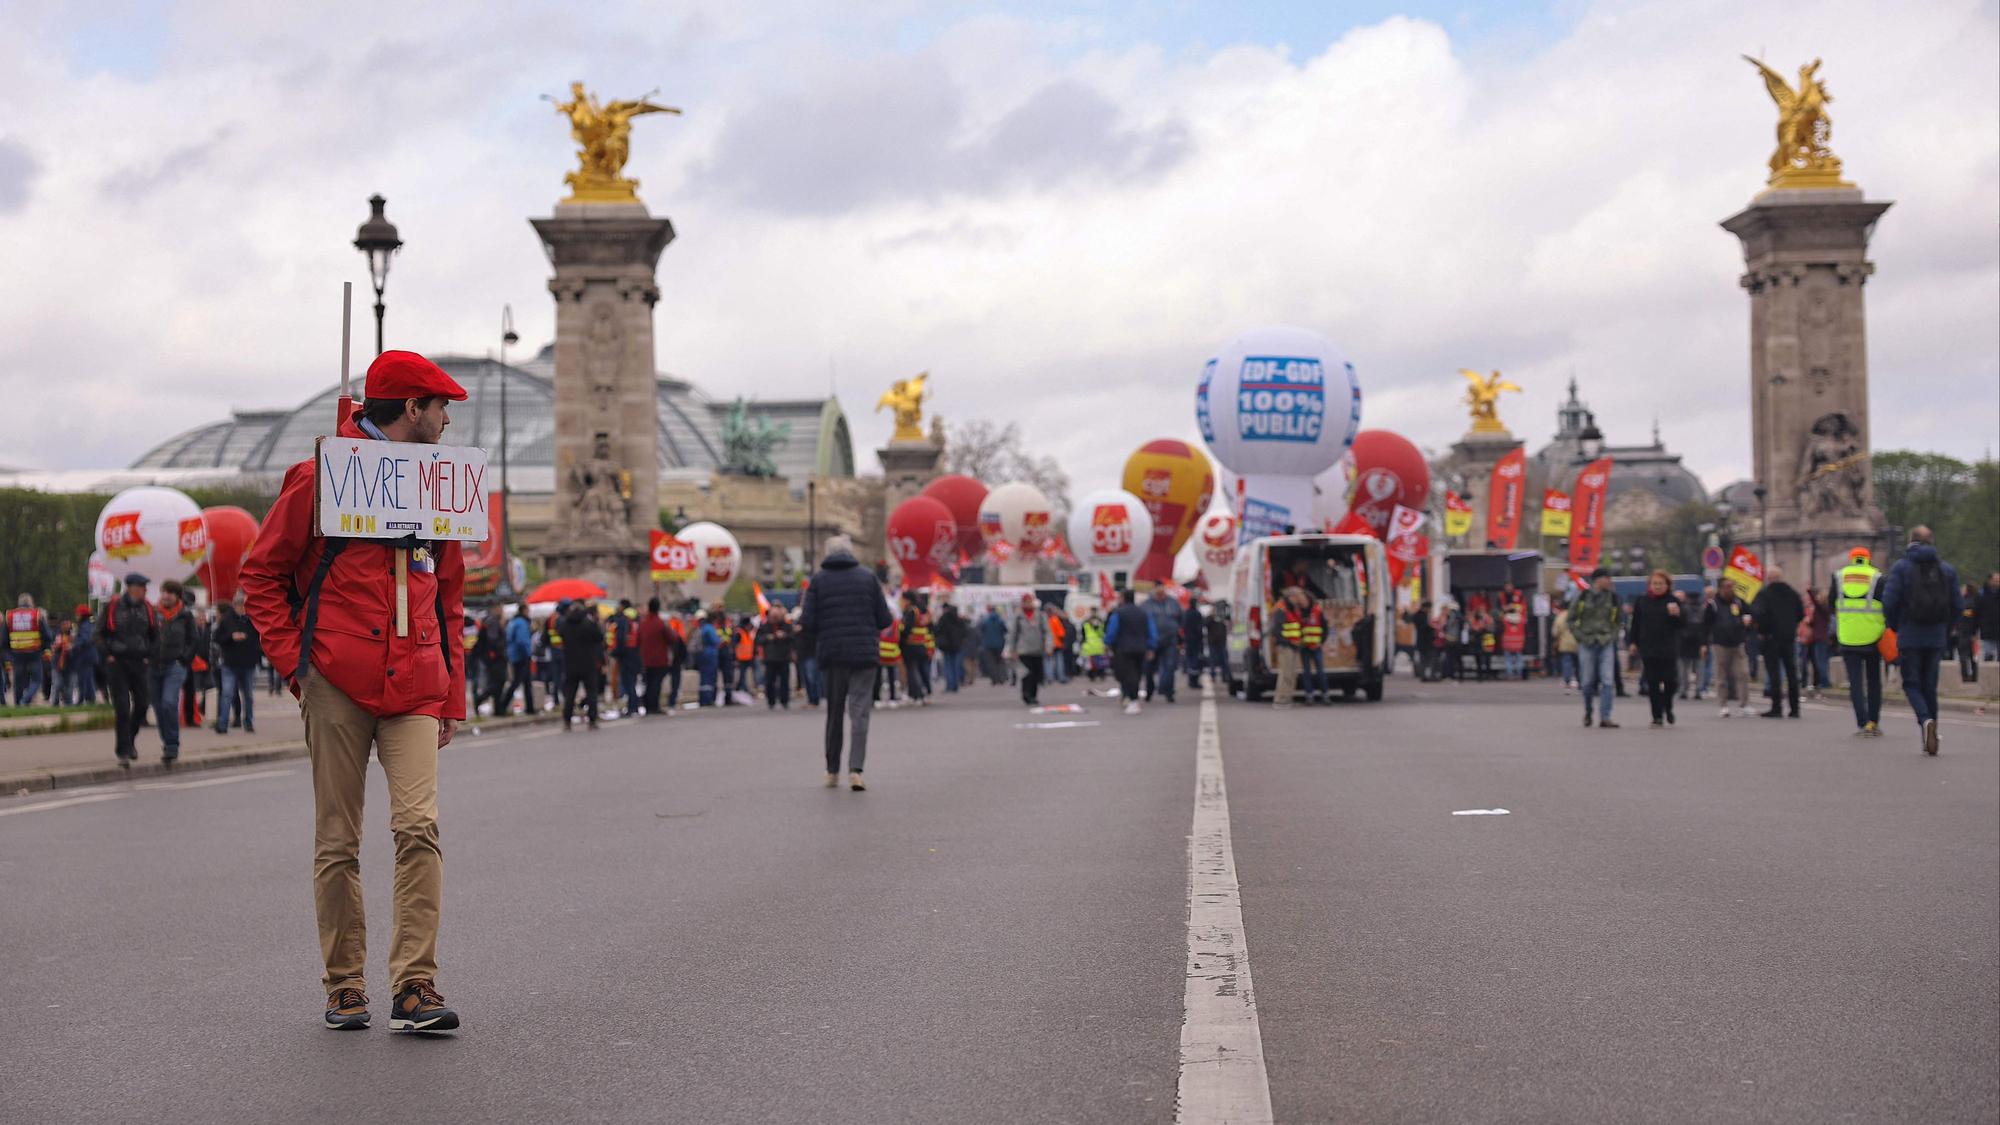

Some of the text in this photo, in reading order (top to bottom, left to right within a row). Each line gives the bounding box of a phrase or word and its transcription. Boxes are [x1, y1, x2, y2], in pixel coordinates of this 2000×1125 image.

[1241, 391, 1322, 414] 100%
[1240, 413, 1321, 437] PUBLIC
[324, 448, 485, 513] VIVRE MIEUX
[103, 521, 132, 548] cgt
[341, 513, 376, 534] NON
[433, 516, 451, 535] 64
[457, 526, 473, 536] ANS
[1093, 522, 1132, 551] cgt
